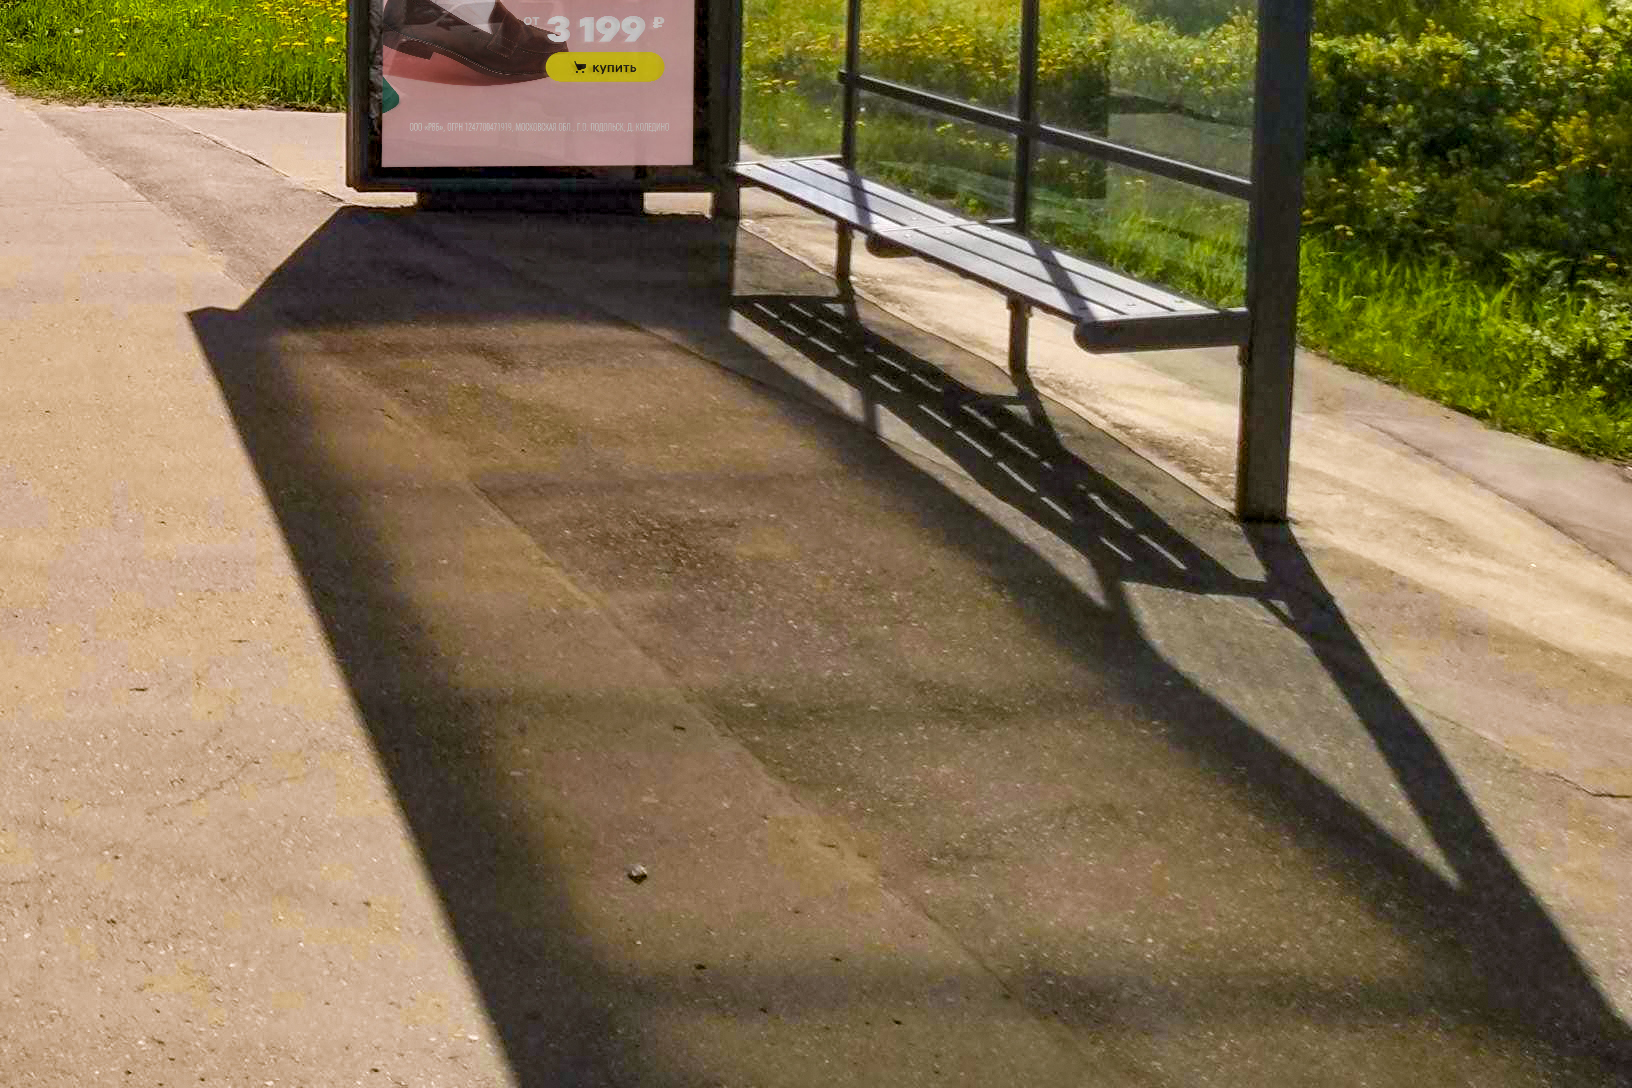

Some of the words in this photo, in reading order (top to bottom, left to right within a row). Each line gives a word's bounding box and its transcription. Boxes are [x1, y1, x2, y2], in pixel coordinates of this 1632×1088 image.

[592, 64, 637, 75] купить
[409, 122, 423, 132] ООО
[447, 122, 464, 132] ОГРН
[515, 122, 557, 132] МОСКОВСКАЯ
[590, 122, 626, 133] ПОДОЛЬСК,
[635, 122, 670, 133] КОЛЕДИНО
